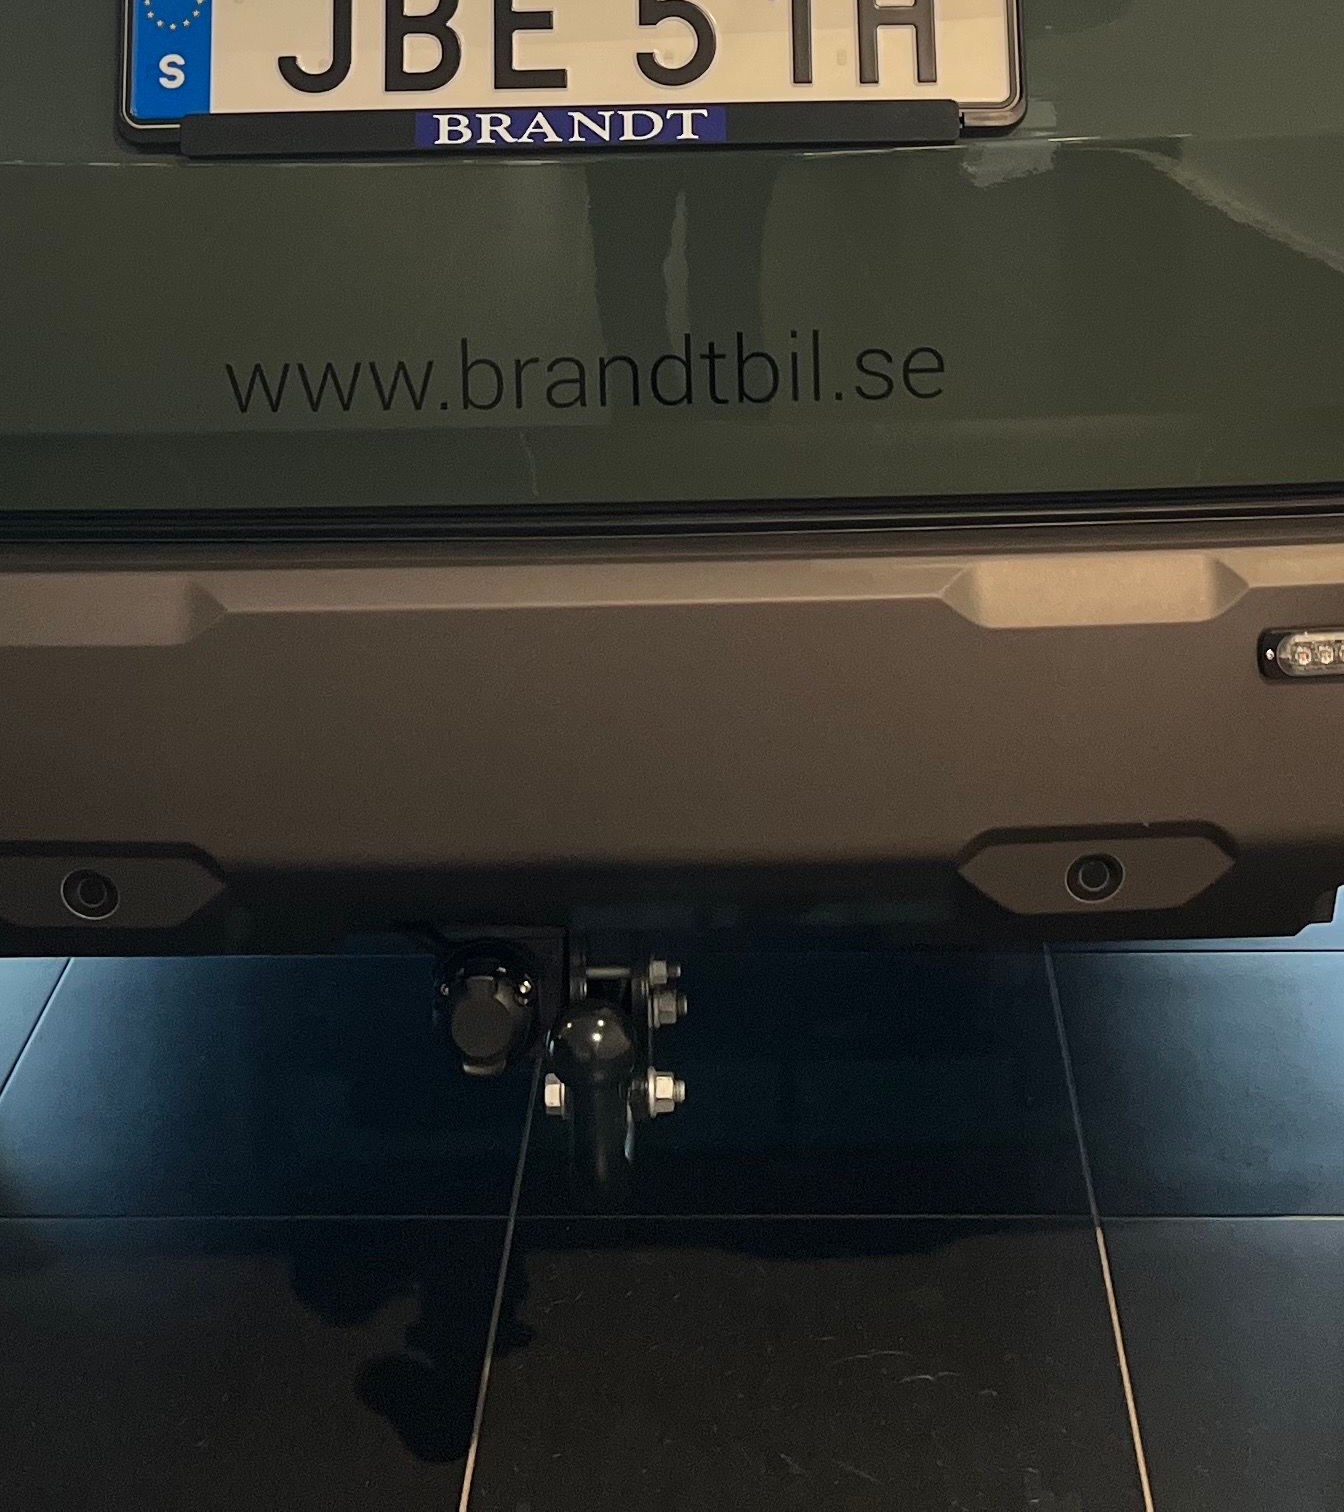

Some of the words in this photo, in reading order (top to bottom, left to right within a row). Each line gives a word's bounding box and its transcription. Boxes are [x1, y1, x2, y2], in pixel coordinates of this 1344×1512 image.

[158, 53, 186, 90] S
[432, 109, 709, 145] BRANDT
[224, 329, 946, 415] www.brandtbil.se
